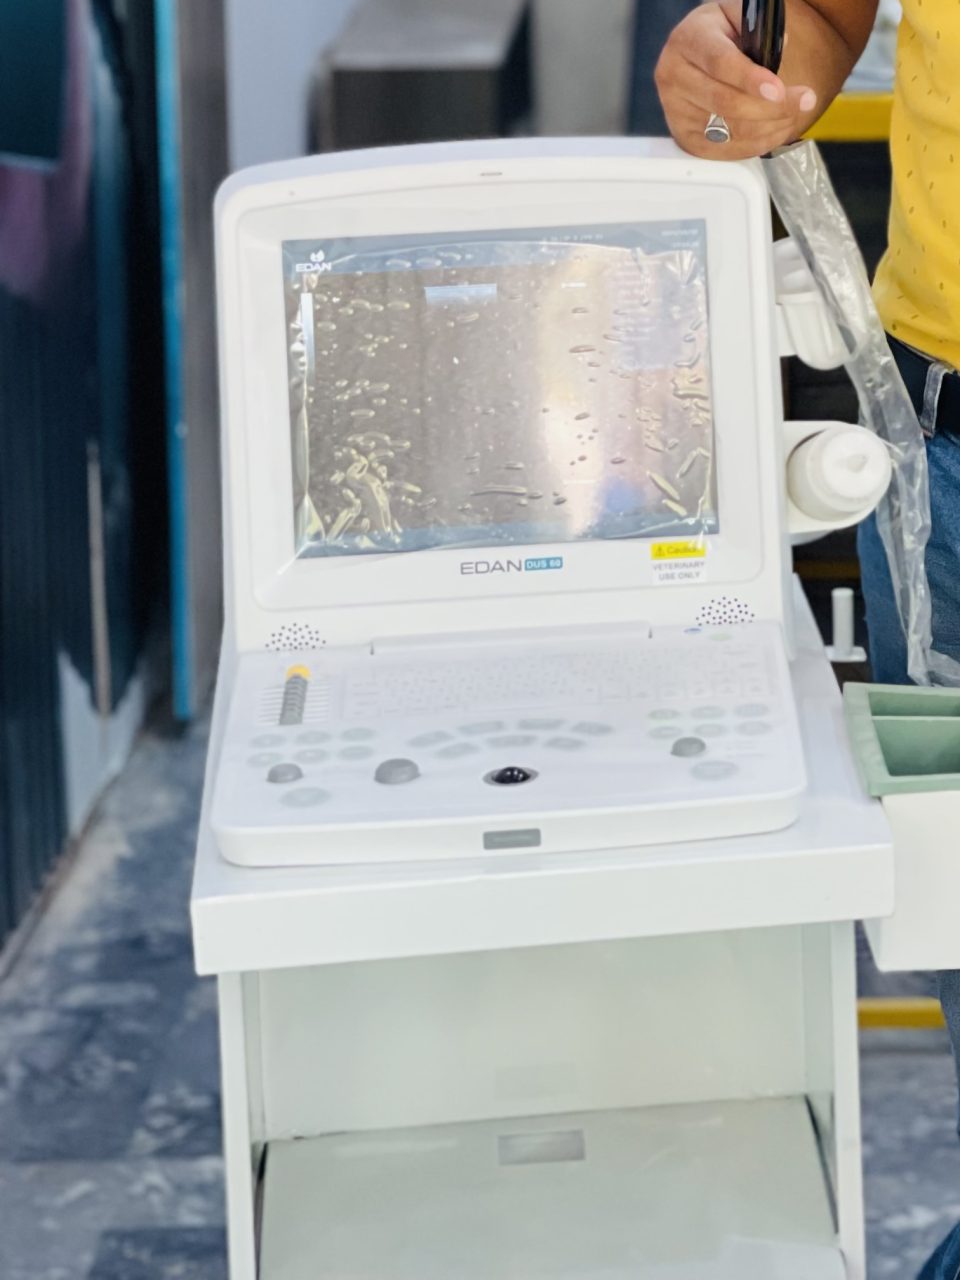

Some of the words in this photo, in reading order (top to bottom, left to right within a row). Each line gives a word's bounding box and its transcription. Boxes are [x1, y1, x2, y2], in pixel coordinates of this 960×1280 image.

[295, 262, 332, 272] EDAN
[460, 559, 522, 575] EDAN
[526, 559, 547, 569] DUS
[653, 561, 705, 571] VETERINARY
[658, 572, 676, 581] USE
[677, 571, 701, 580] ONLY
